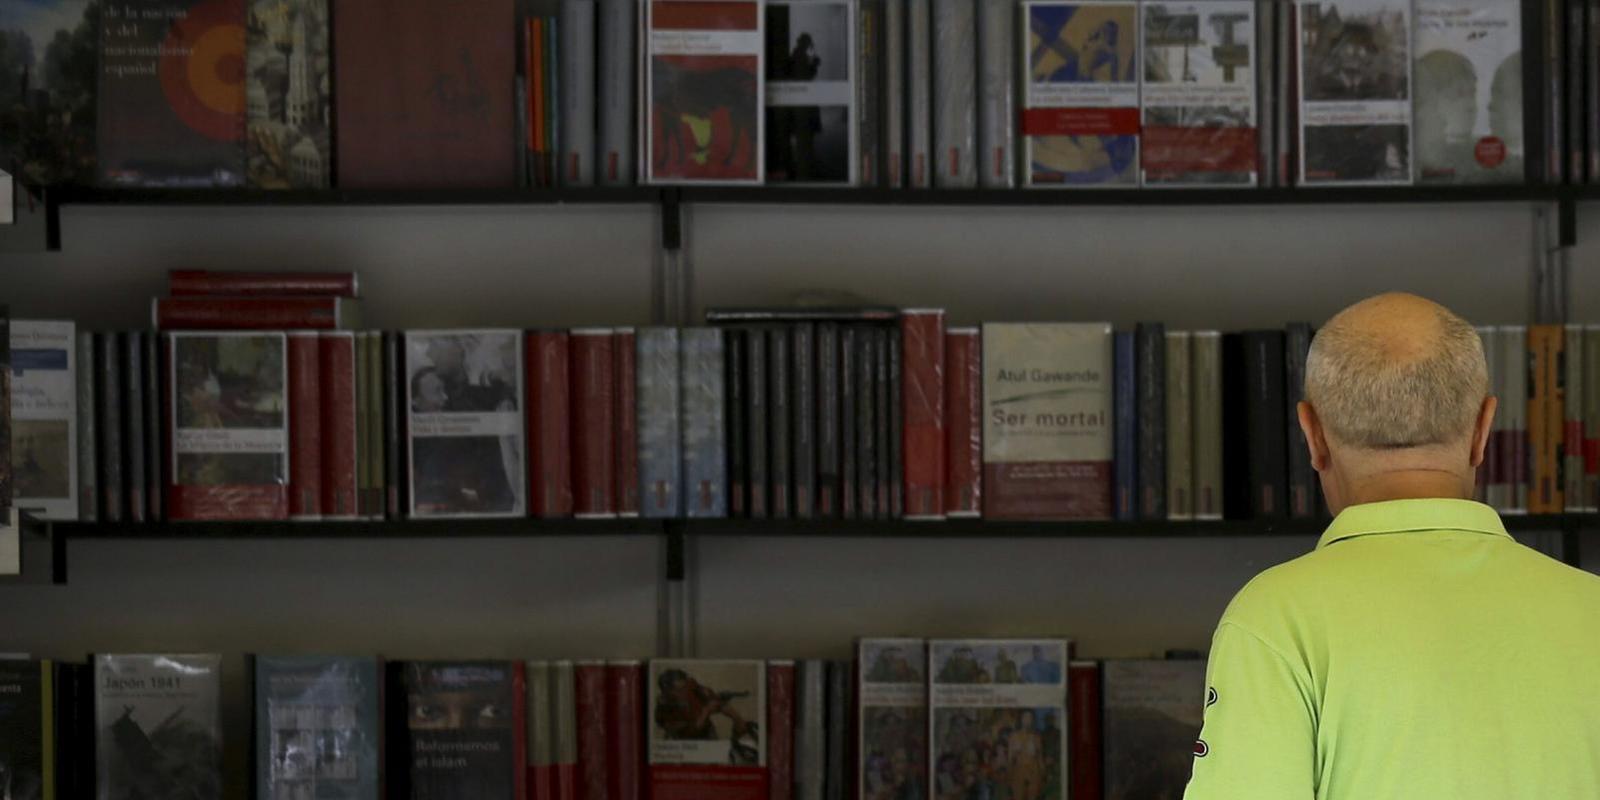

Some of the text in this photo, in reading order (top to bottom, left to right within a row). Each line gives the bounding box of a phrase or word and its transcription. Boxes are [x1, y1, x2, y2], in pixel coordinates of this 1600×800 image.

[104, 5, 121, 18] de
[125, 5, 138, 18] la
[116, 23, 138, 37] del
[104, 43, 194, 57] nacionalismo
[104, 60, 157, 79] español
[997, 368, 1100, 382] Atul Gawande
[992, 409, 1105, 427] Ser mortal
[104, 676, 182, 691] Japón 1941
[415, 739, 501, 753] Reformemos
[415, 755, 468, 769] el islam
